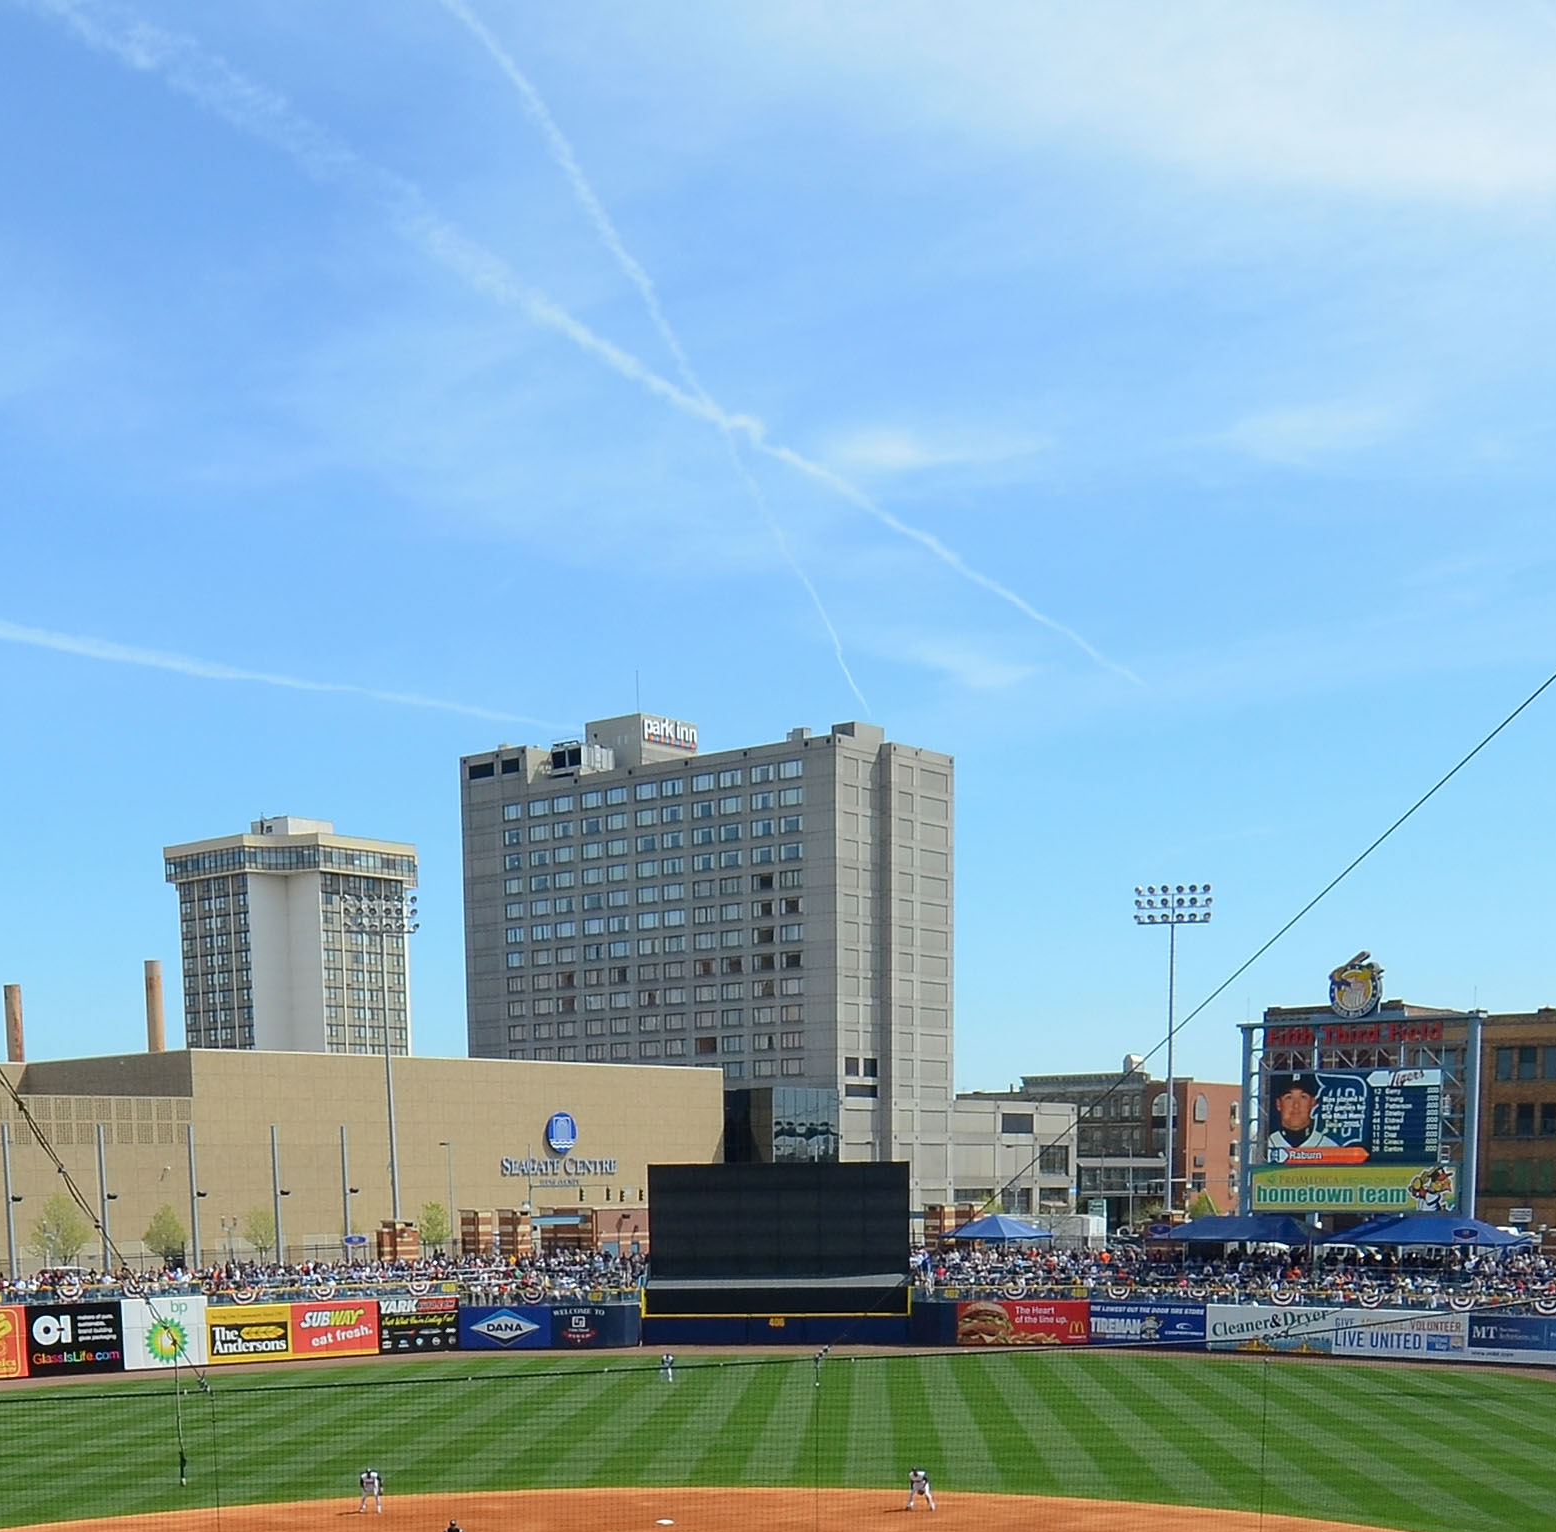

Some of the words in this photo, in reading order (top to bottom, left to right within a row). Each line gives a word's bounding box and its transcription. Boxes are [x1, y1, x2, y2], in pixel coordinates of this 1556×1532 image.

[1268, 1027, 1315, 1045] Fifth
[1321, 1023, 1379, 1044] Third
[1389, 1021, 1442, 1041] Field
[1257, 1186, 1353, 1203] hometown
[1359, 1187, 1407, 1203] team
[171, 1300, 188, 1315] bp
[380, 1300, 418, 1314] YARK
[553, 1308, 591, 1316] WELCOME
[1015, 1306, 1030, 1314] The
[1032, 1306, 1055, 1314] Heart
[300, 1309, 365, 1328] SUBWAY
[1055, 1316, 1067, 1324] up.
[1090, 1318, 1141, 1334] TIREMAN
[1335, 1318, 1354, 1327] GIVE
[212, 1327, 238, 1340] The
[486, 1324, 523, 1332] DANA
[1472, 1326, 1498, 1339] MT
[312, 1332, 333, 1347] eat
[336, 1325, 373, 1341] fresh.
[1335, 1331, 1365, 1347] LIVE
[1371, 1332, 1421, 1350] UNITED
[213, 1337, 286, 1354] Andersons
[33, 1350, 120, 1365] GlassIsLife.com
